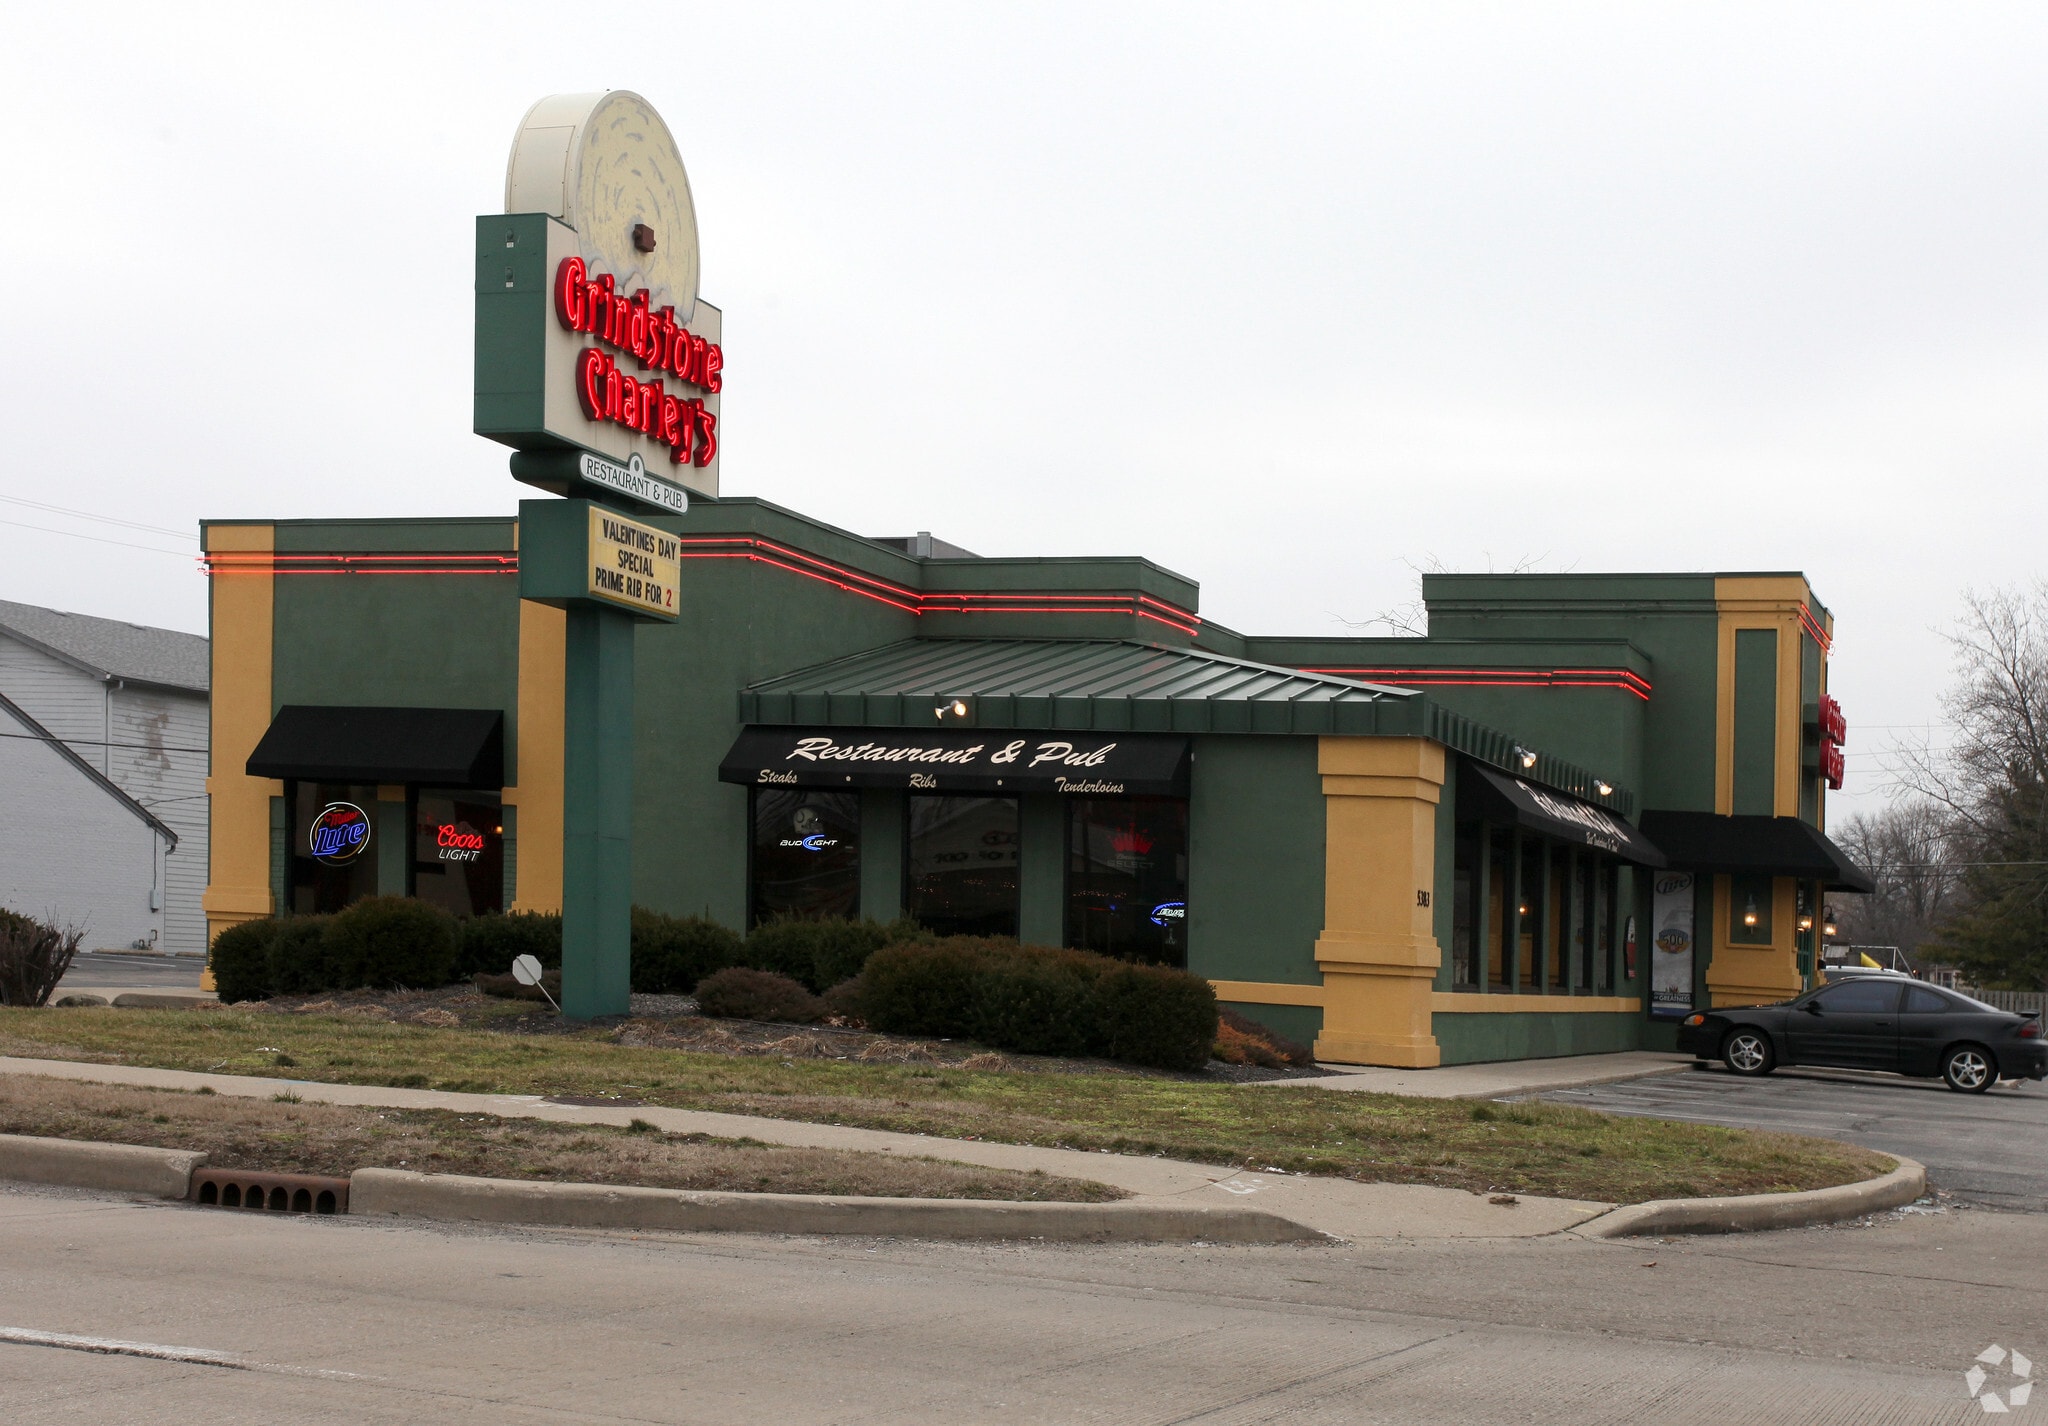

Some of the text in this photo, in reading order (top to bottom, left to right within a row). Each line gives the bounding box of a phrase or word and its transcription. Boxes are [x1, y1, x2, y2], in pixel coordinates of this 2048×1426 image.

[555, 257, 723, 394] Grindstone
[576, 348, 717, 467] Charley's
[586, 458, 683, 509] RESTAURANT & PUB
[603, 518, 677, 560] VALENTINES DAY
[618, 549, 654, 578] SPECIAL
[595, 566, 673, 607] PRIME RIB FOR 2
[786, 737, 1117, 768] Restaurant & Pub
[757, 769, 799, 784] Steaks
[908, 773, 938, 788] Ribs
[1054, 776, 1125, 793] Tenderloins
[312, 822, 366, 856] Lite
[437, 824, 485, 850] Coors
[779, 839, 803, 847] BUD
[438, 848, 480, 862] LIGHT
[1662, 933, 1684, 946] 500
